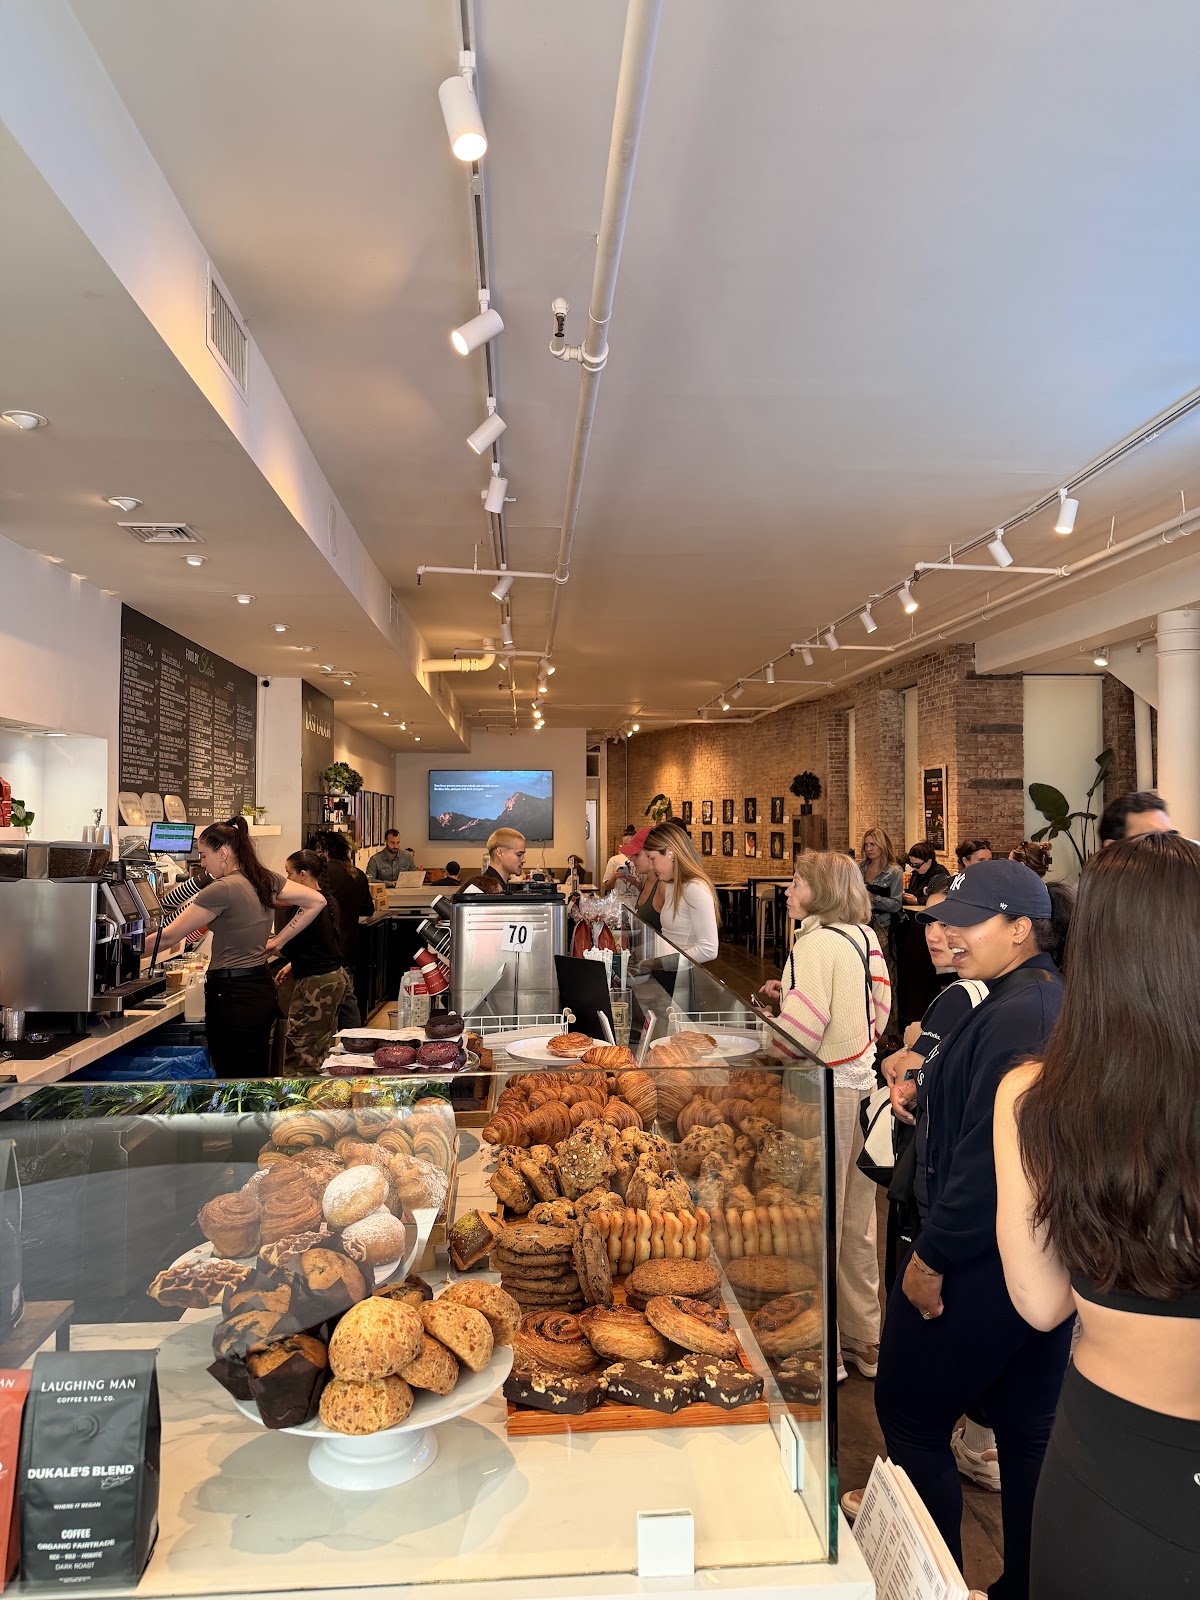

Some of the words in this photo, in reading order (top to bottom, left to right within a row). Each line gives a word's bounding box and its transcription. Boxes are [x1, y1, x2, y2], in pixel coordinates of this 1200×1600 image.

[508, 924, 528, 945] 70
[40, 1379, 105, 1393] LAUGHING
[109, 1378, 136, 1390] MAN
[56, 1396, 82, 1404] COFFEE
[89, 1395, 102, 1403] TEA
[27, 1466, 90, 1480] DUKALE'S
[91, 1464, 135, 1477] BLEND
[61, 1528, 91, 1540] COFFEE
[37, 1542, 71, 1551] ORGANIC
[72, 1539, 115, 1550] FAIRTRADE
